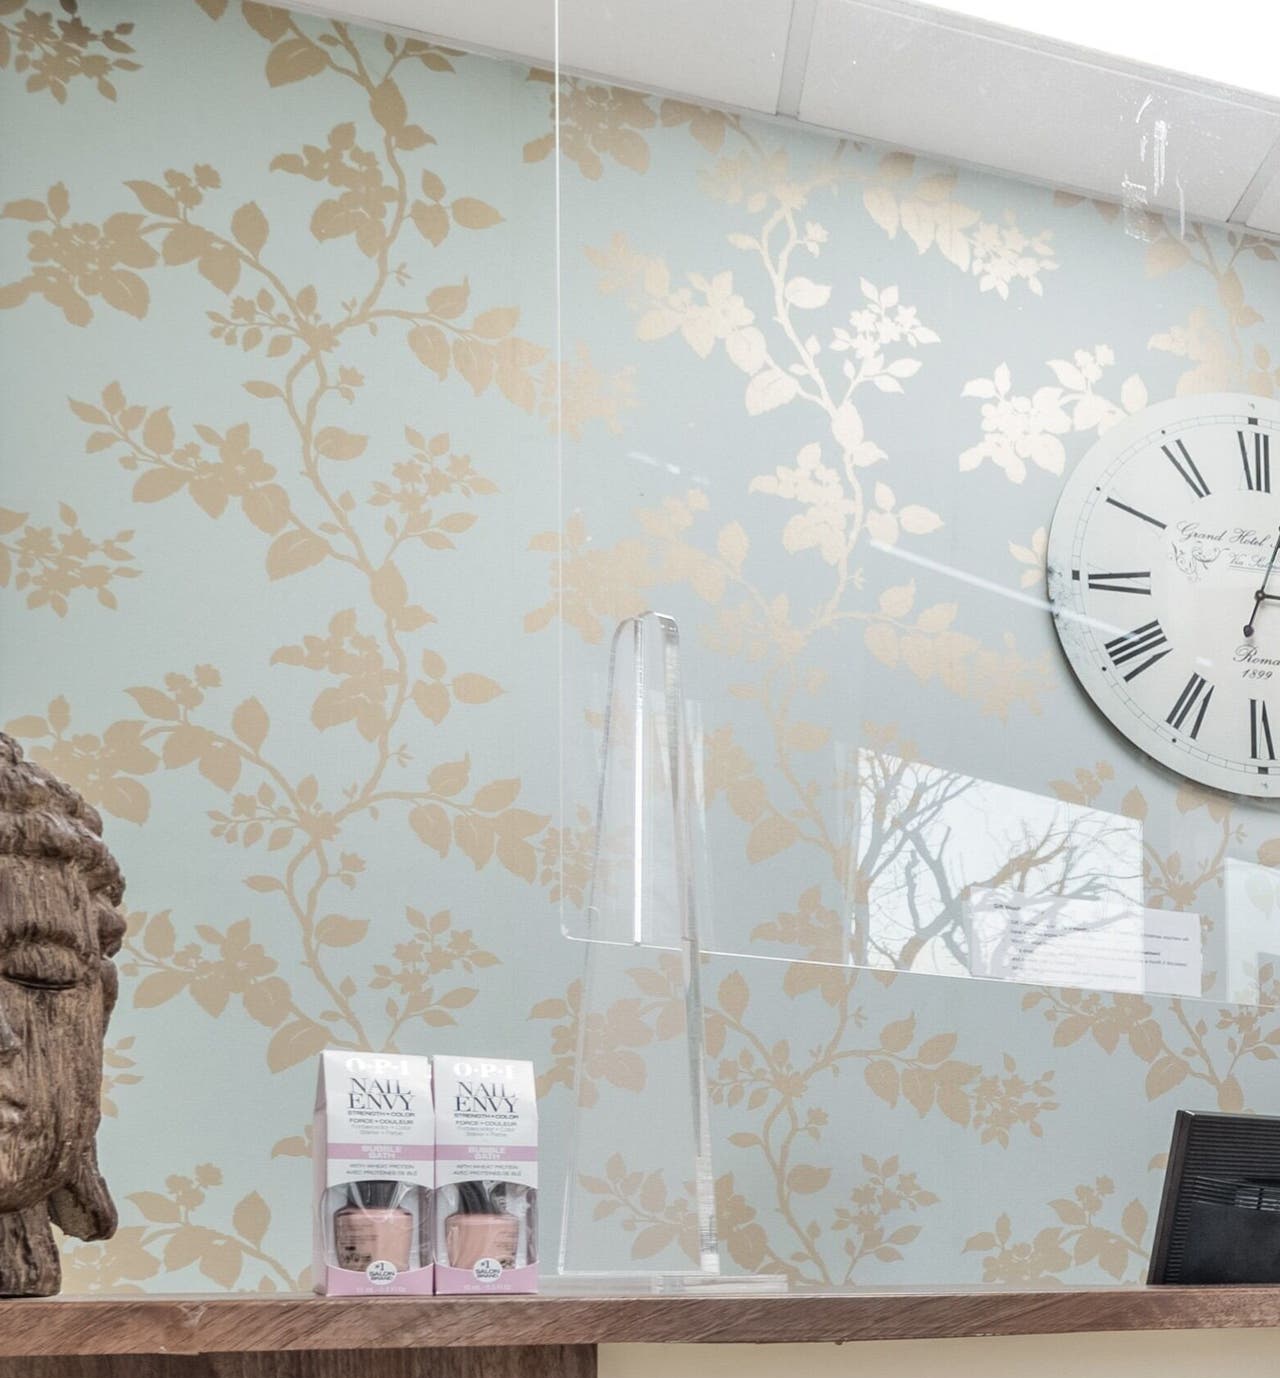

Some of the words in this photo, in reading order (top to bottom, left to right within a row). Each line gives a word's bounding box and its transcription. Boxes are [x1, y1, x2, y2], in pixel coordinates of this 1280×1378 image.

[1177, 521, 1227, 541] Grand
[1229, 528, 1271, 547] Hotel
[1233, 644, 1280, 666] Roma
[1242, 669, 1273, 680] 1899
[348, 1077, 411, 1095] NAIL
[455, 1081, 517, 1098] NAIL
[347, 1092, 416, 1110] ENVY
[454, 1096, 519, 1113] ENVY
